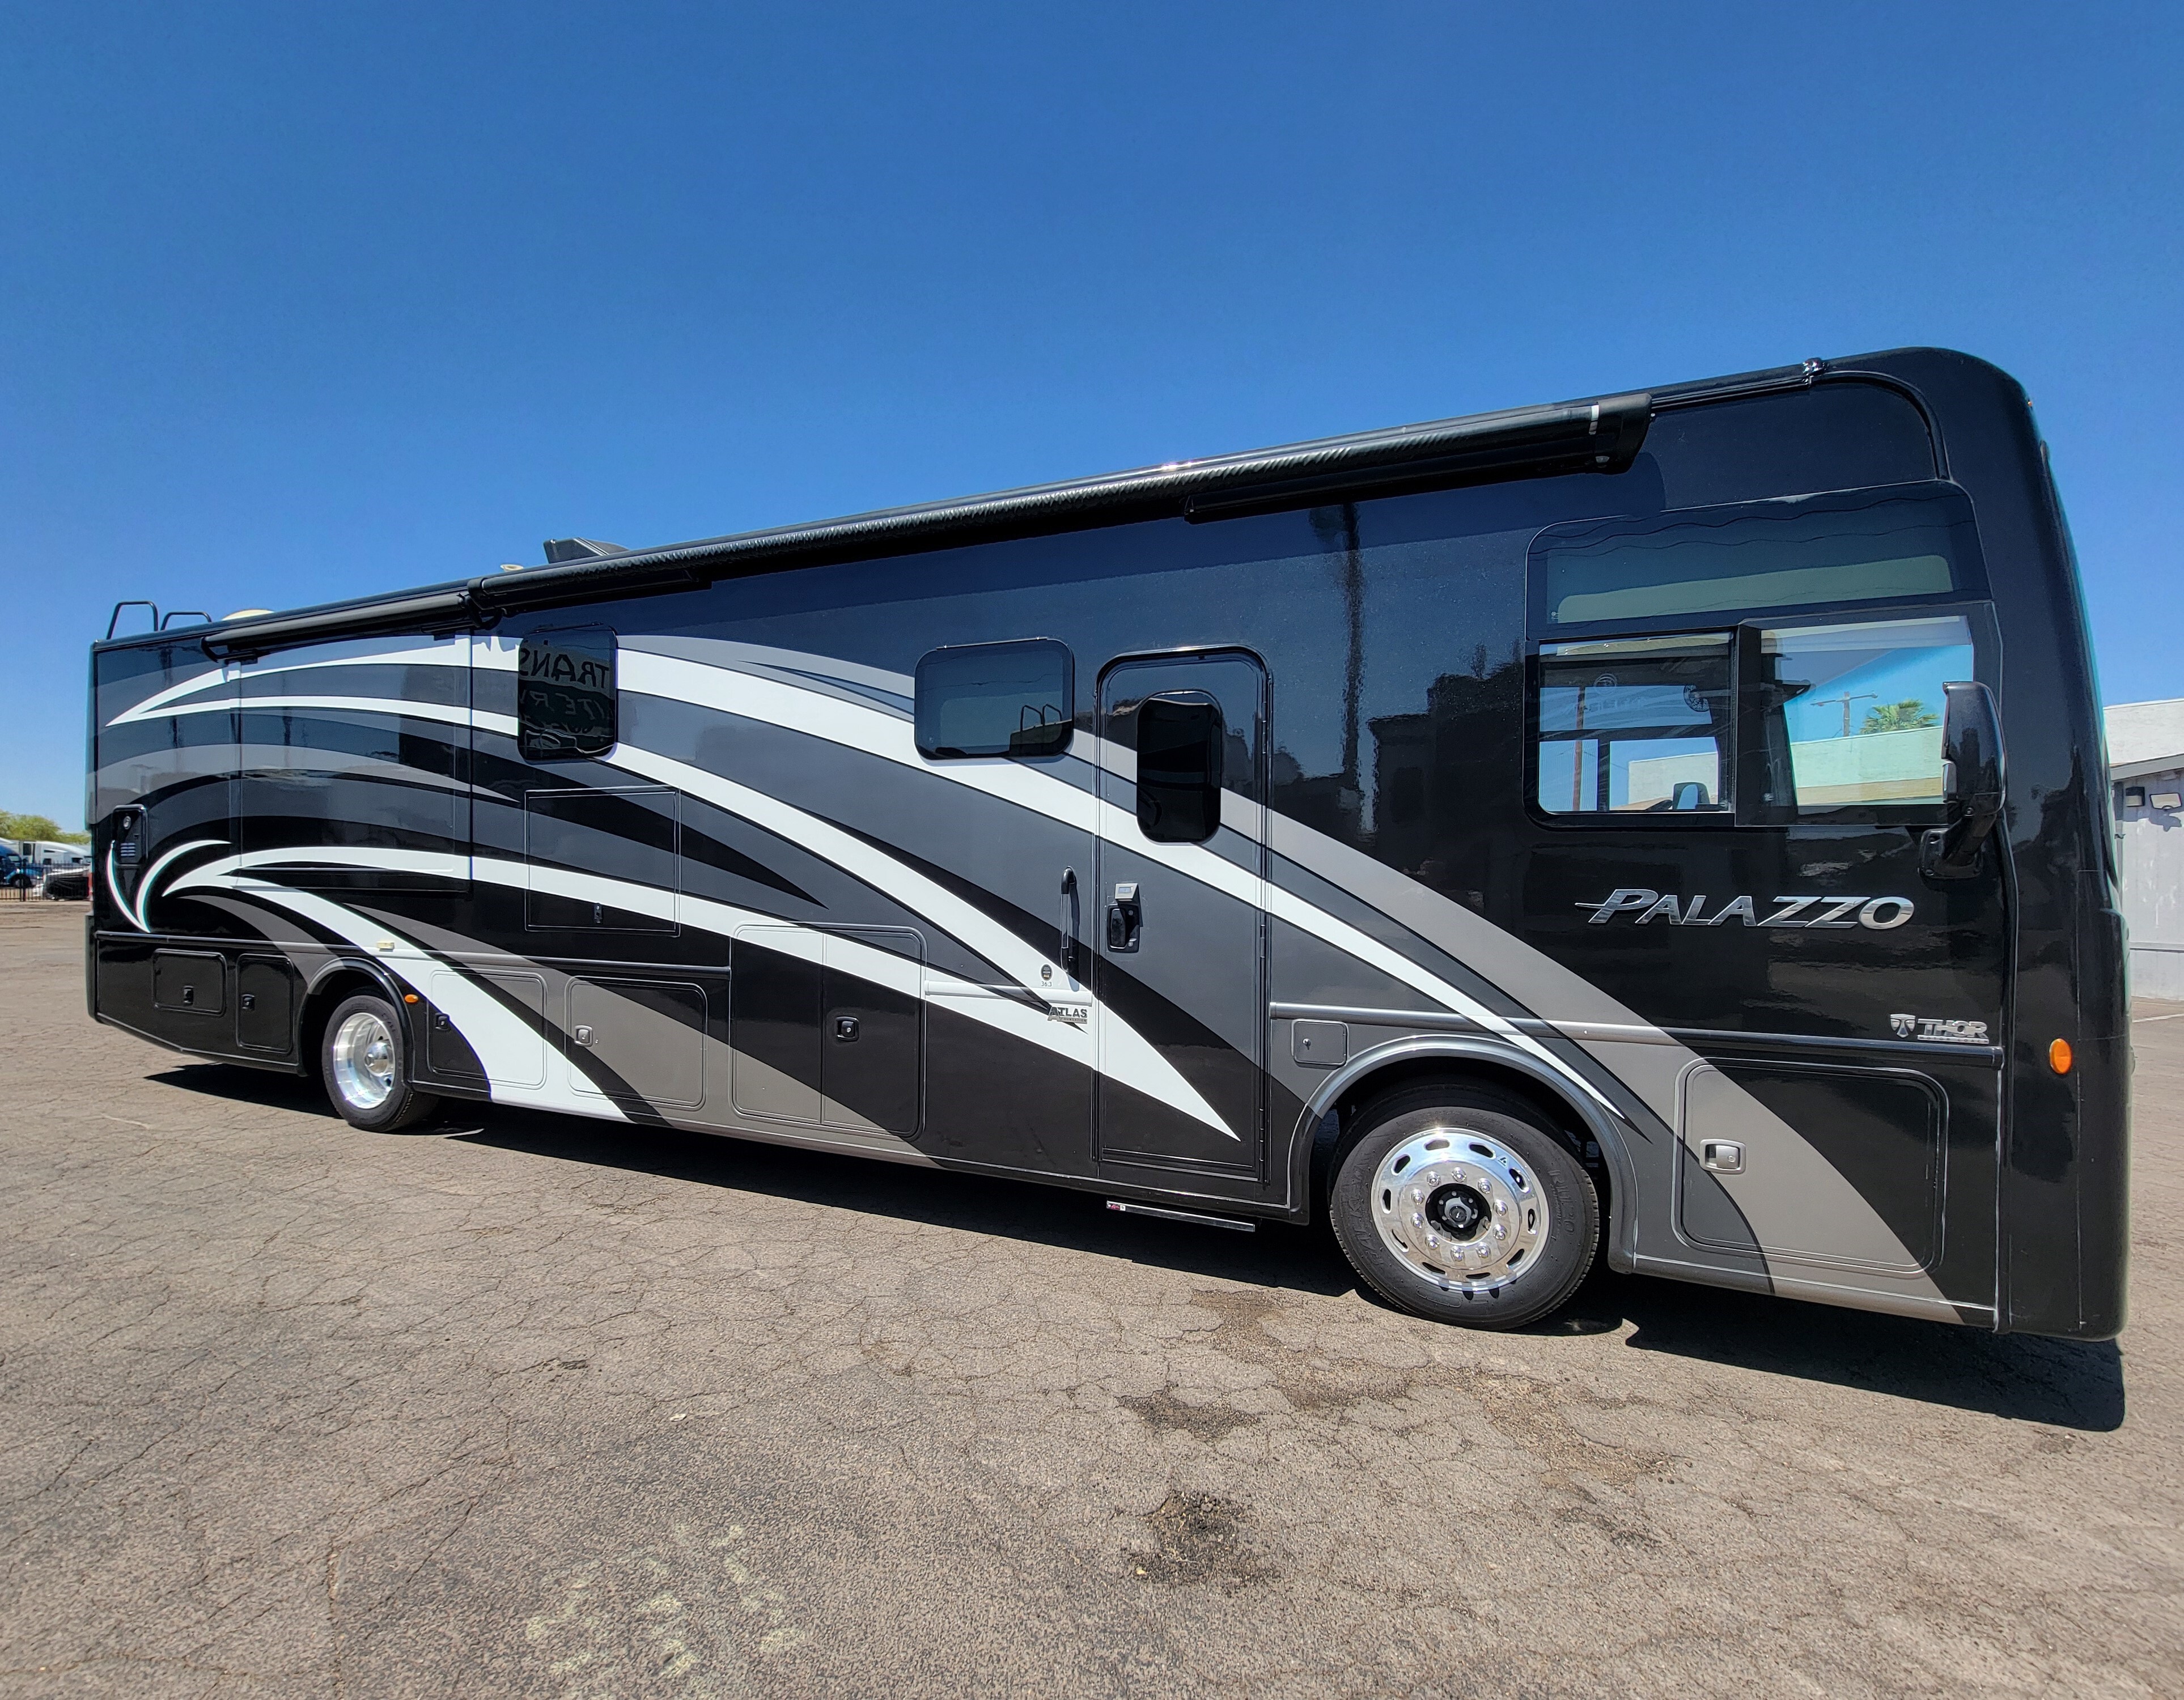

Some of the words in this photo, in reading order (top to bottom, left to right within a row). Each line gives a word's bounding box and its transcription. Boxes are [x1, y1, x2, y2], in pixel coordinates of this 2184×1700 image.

[1575, 889, 1915, 930] PALAZZO
[1048, 1006, 1088, 1021] ATLAS
[1917, 1018, 1989, 1039] THOR
